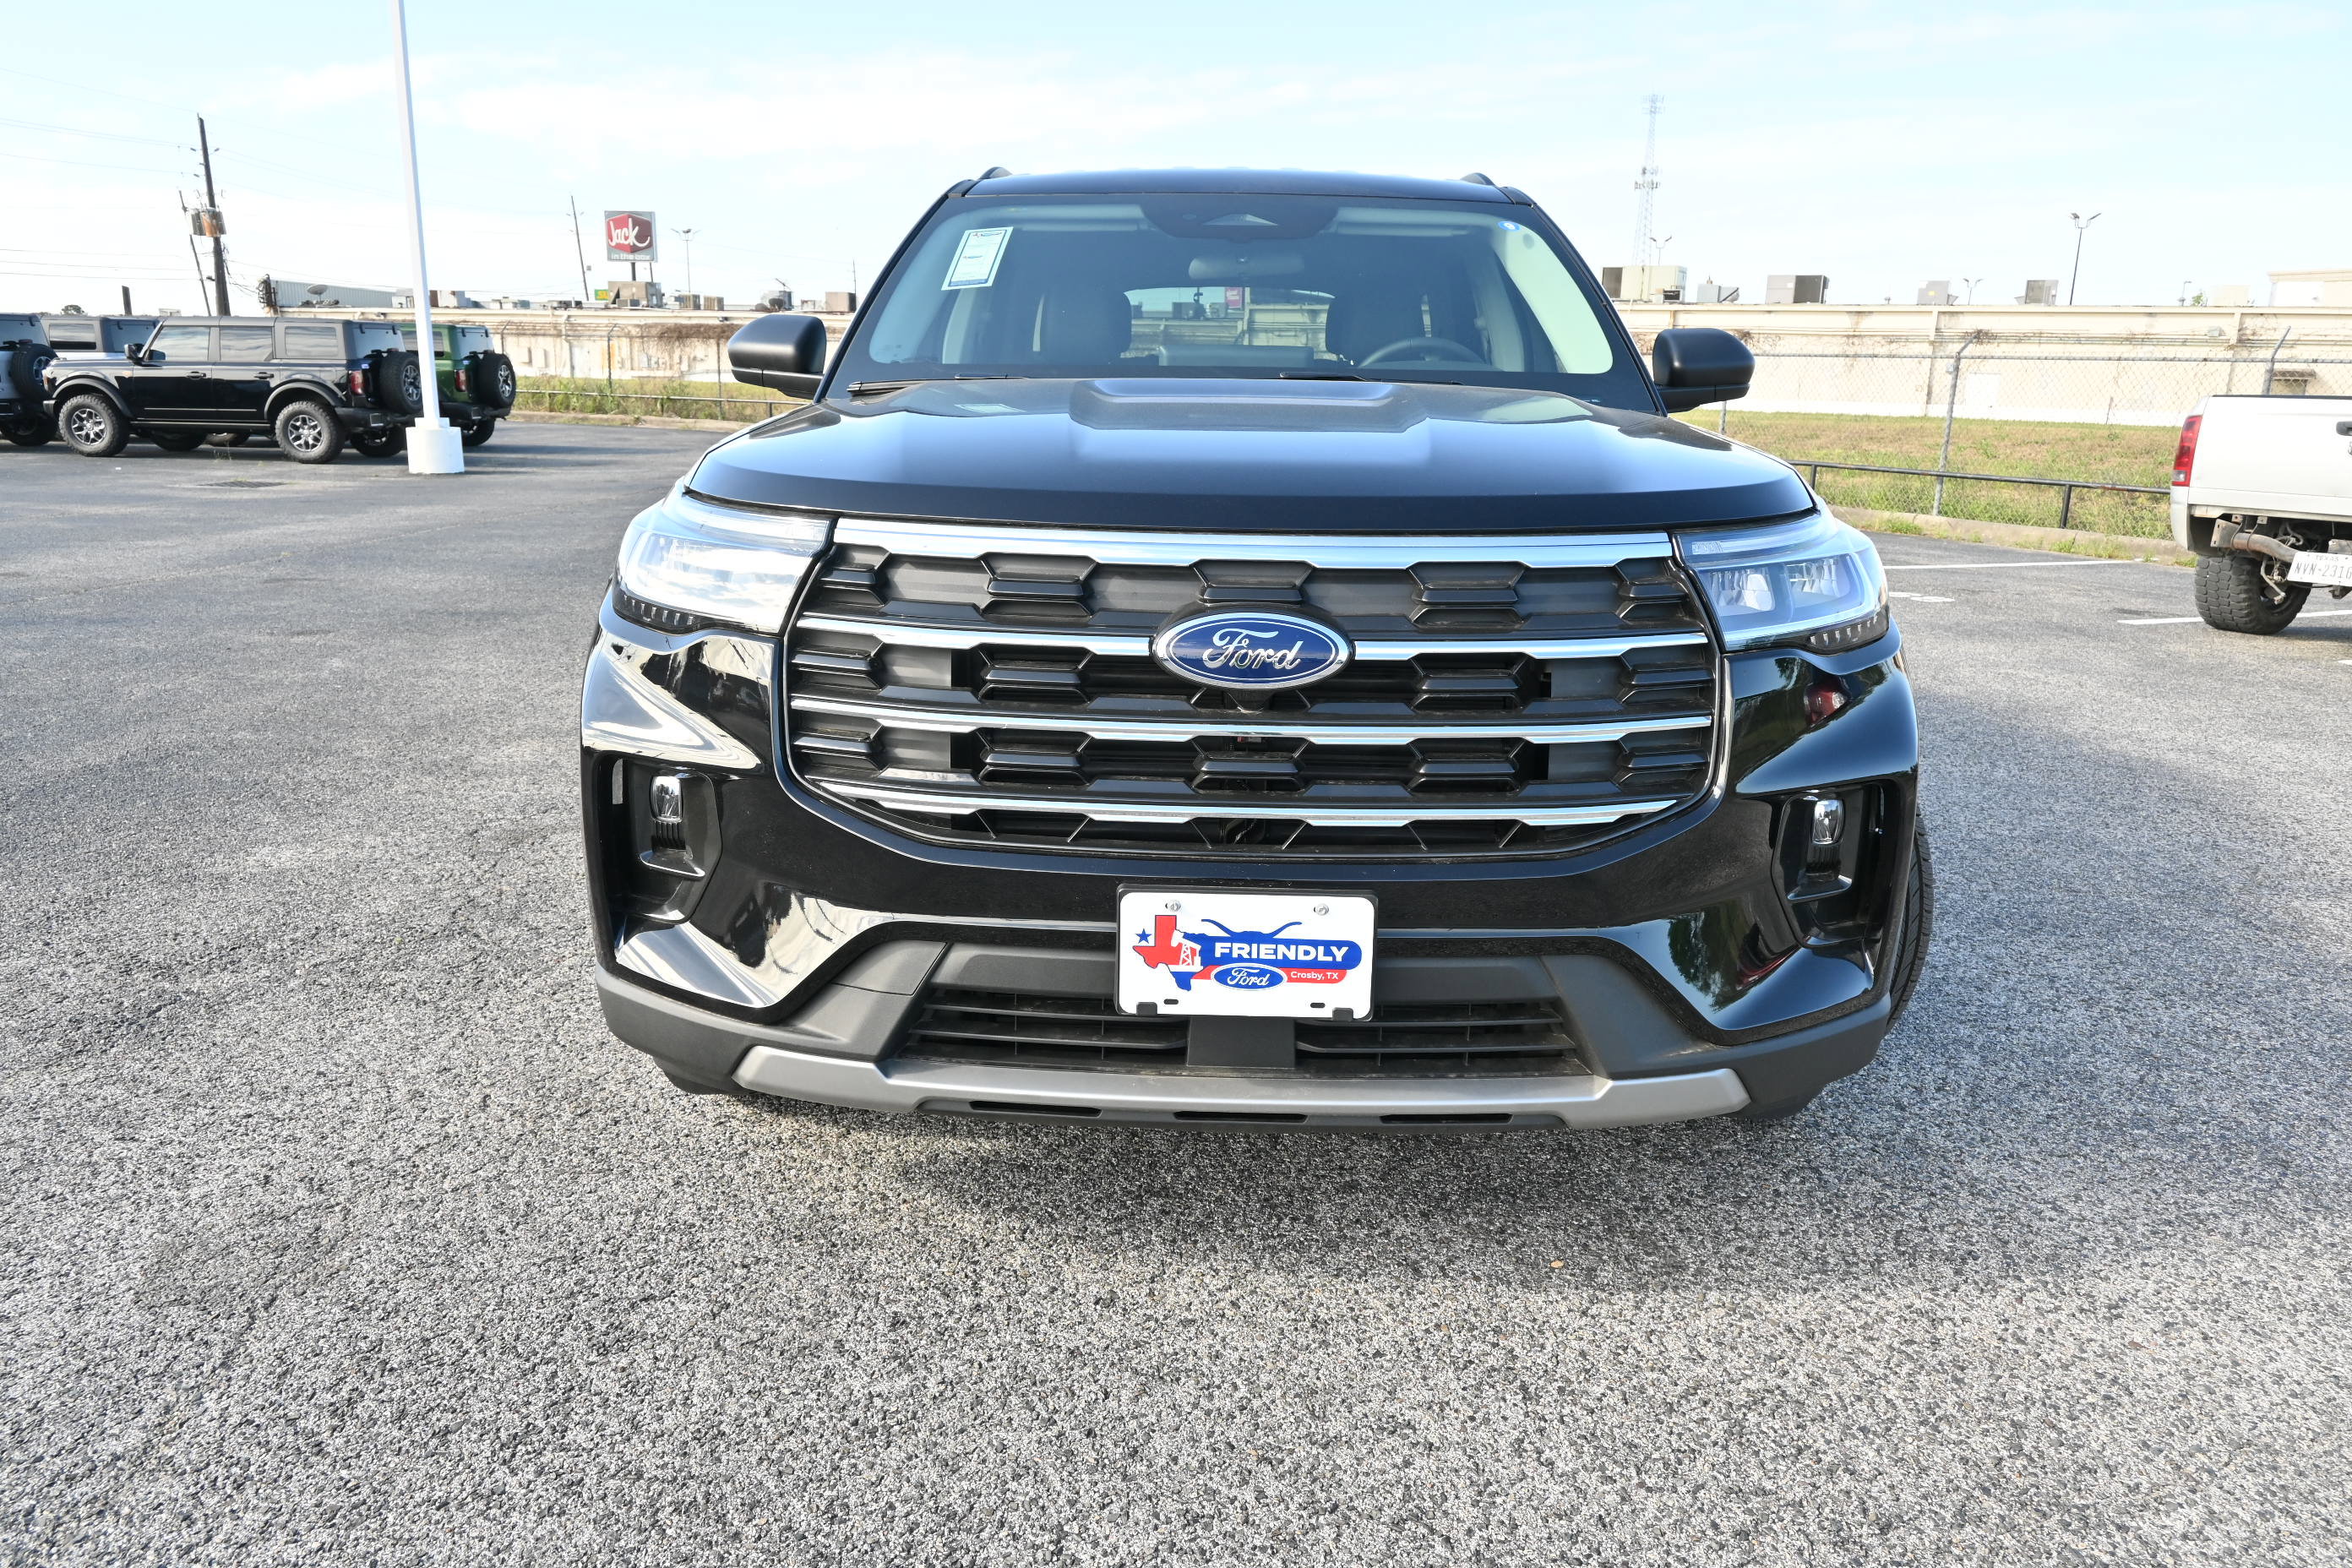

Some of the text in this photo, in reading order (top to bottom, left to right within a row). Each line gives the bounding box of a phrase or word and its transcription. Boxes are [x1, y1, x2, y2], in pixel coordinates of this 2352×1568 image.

[607, 217, 651, 248] Jack
[1202, 628, 1304, 669] Ford
[1214, 942, 1349, 962] FRIENDLY
[1227, 967, 1271, 986] Ford
[1290, 971, 1325, 981] Crosby,
